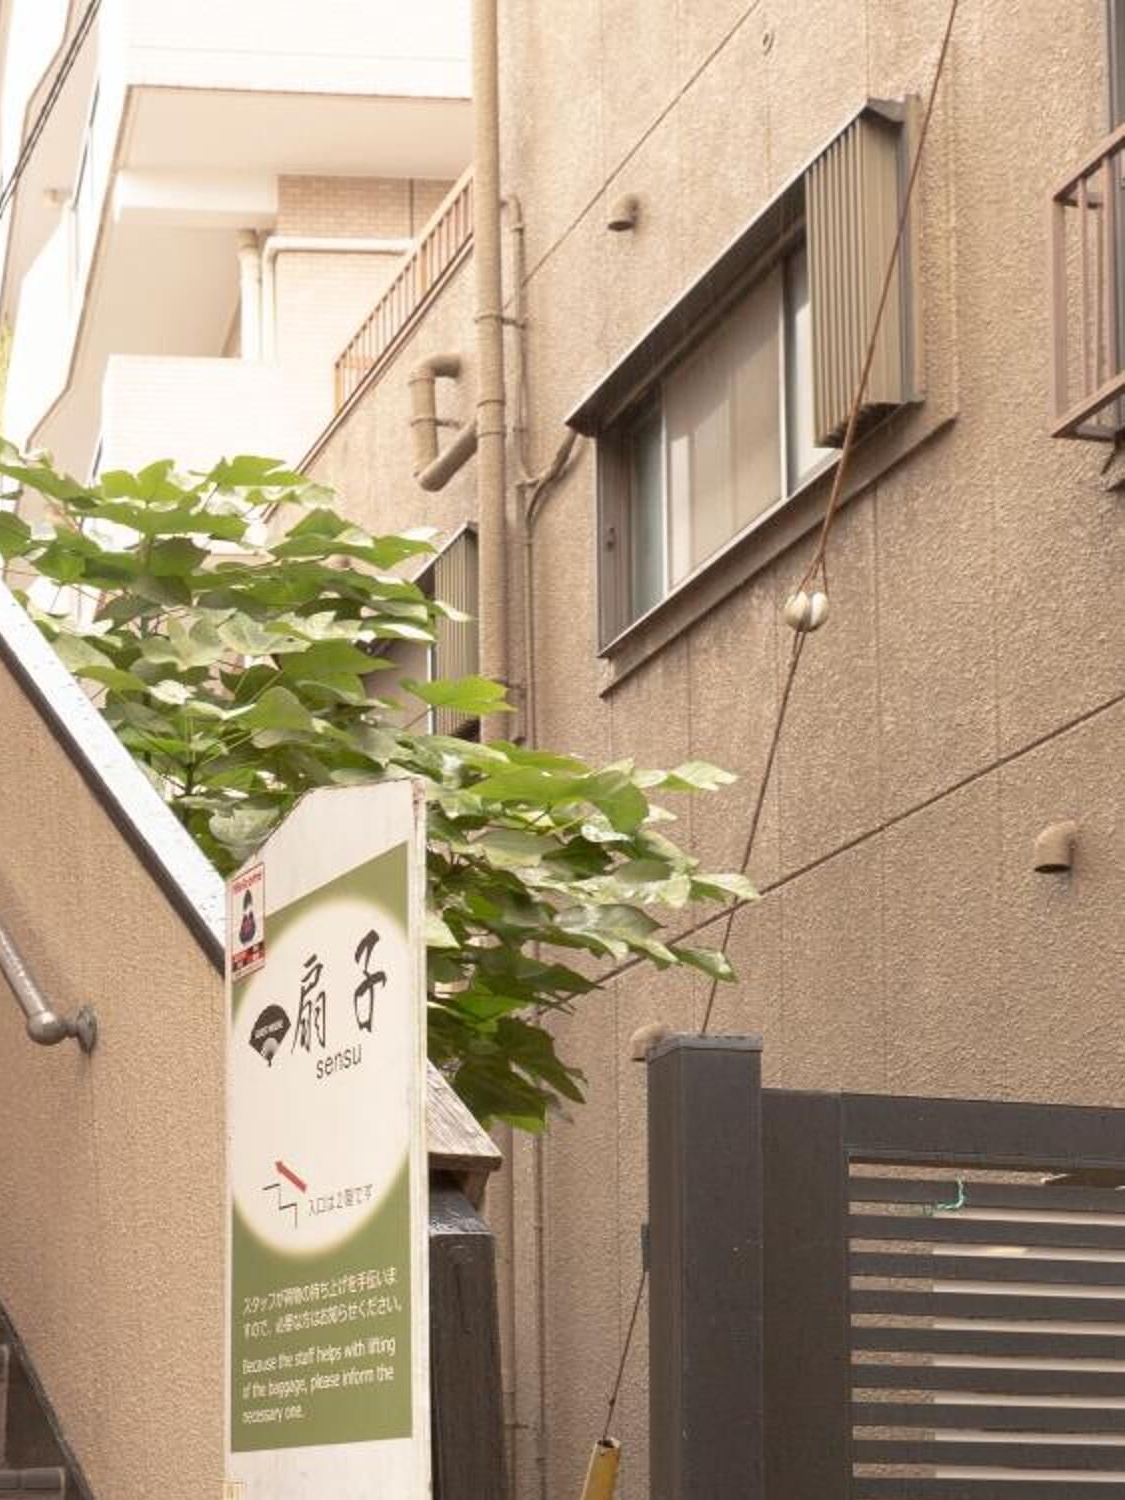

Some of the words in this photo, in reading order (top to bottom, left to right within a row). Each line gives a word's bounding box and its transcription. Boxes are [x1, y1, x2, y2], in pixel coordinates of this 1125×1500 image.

[316, 1044, 362, 1079] sensu
[242, 1357, 276, 1374] Because
[278, 1353, 293, 1369] the
[317, 1345, 341, 1364] helps
[344, 1339, 365, 1358] with
[252, 1381, 267, 1399] the
[310, 1373, 339, 1397] please
[342, 1366, 373, 1387] inform
[376, 1363, 394, 1382] the
